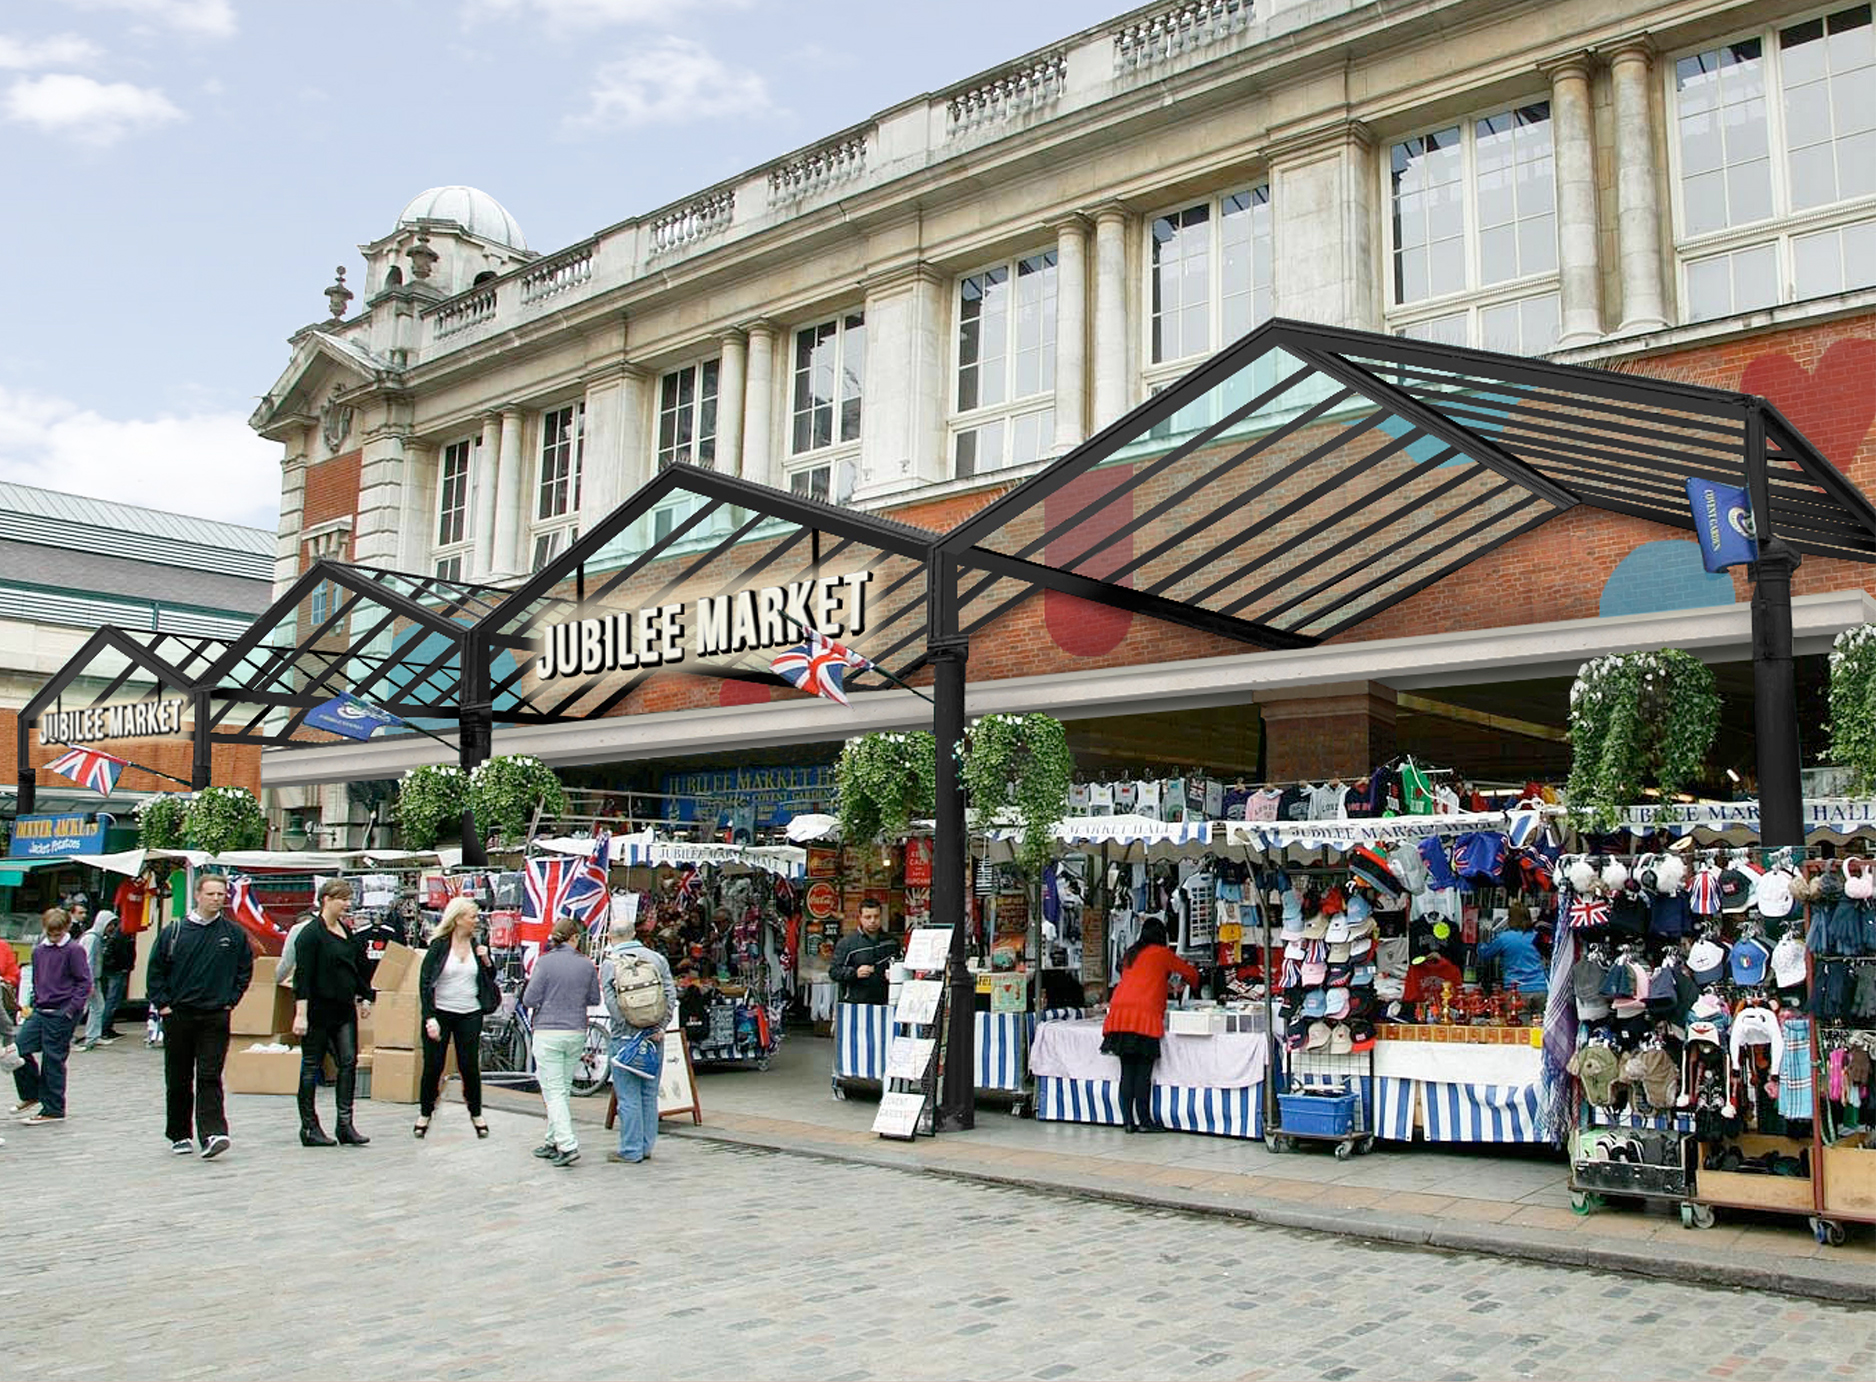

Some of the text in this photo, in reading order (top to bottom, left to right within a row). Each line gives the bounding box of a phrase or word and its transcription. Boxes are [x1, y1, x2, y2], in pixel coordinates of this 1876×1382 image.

[536, 570, 874, 681] JUBILEE MARKET
[39, 698, 184, 745] JUBILEE MARKET
[668, 773, 732, 796] JUBILEE
[736, 768, 808, 791] MARKET
[1708, 806, 1760, 821] MAR
[1813, 804, 1875, 821] HALL
[1291, 826, 1356, 840] JUBILEE
[1360, 823, 1437, 840] MARKET
